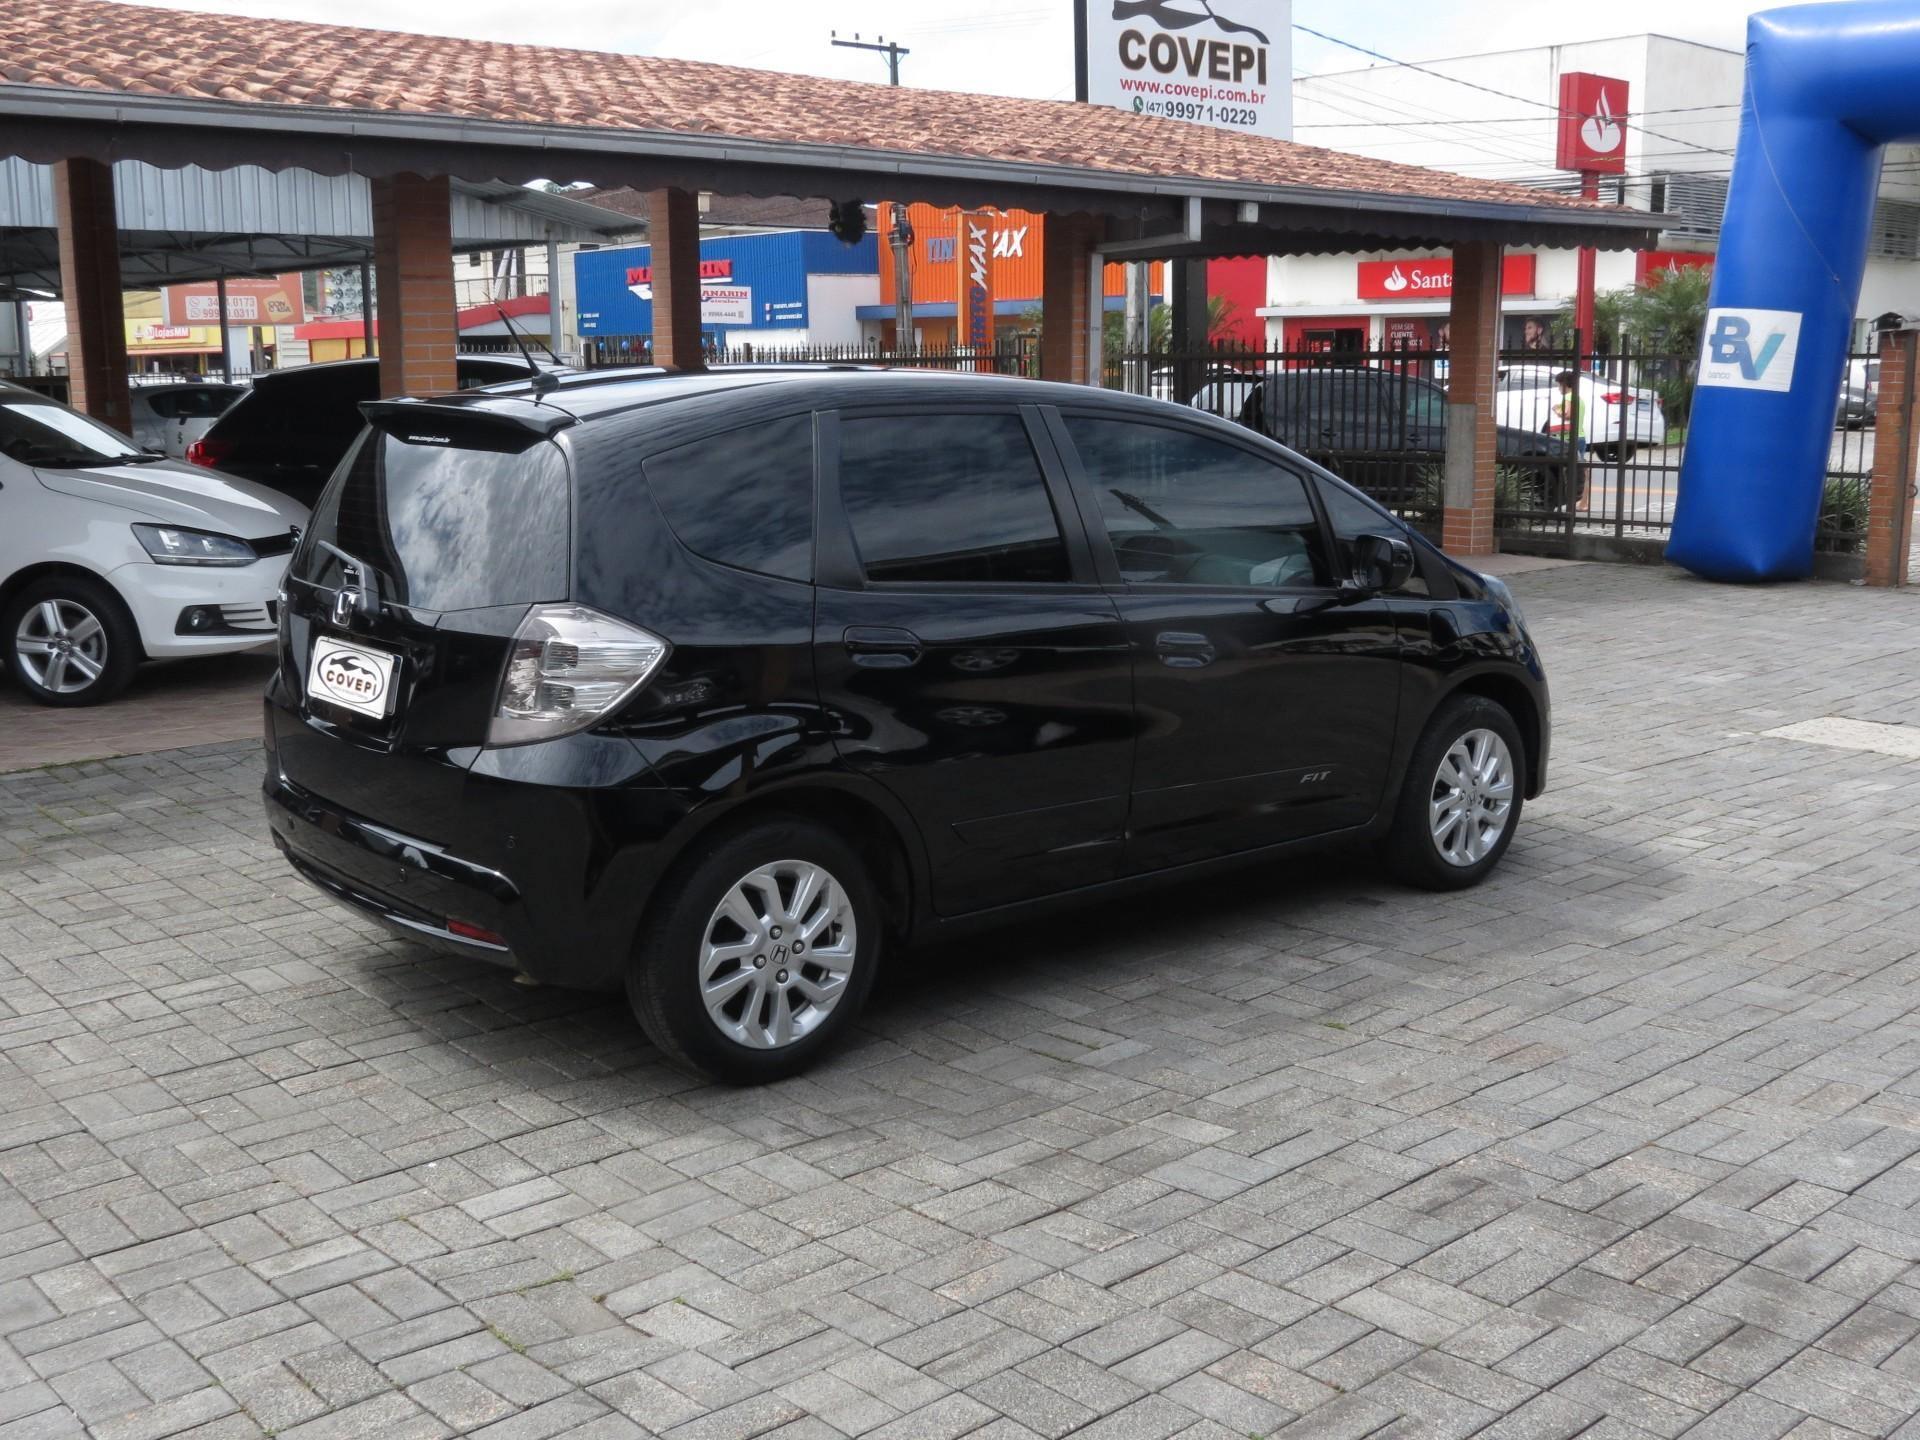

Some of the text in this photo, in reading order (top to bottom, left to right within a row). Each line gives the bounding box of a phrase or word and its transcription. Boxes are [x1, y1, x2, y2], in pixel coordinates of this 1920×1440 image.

[1118, 29, 1267, 86] COVEPI
[1120, 78, 1266, 105] www.covepi.com.br
[1165, 100, 1257, 126] 99971-0229
[702, 289, 748, 299] ANARIN
[1709, 316, 1787, 381] BV
[326, 669, 377, 697] COVEPI
[1300, 770, 1331, 784] FIT
